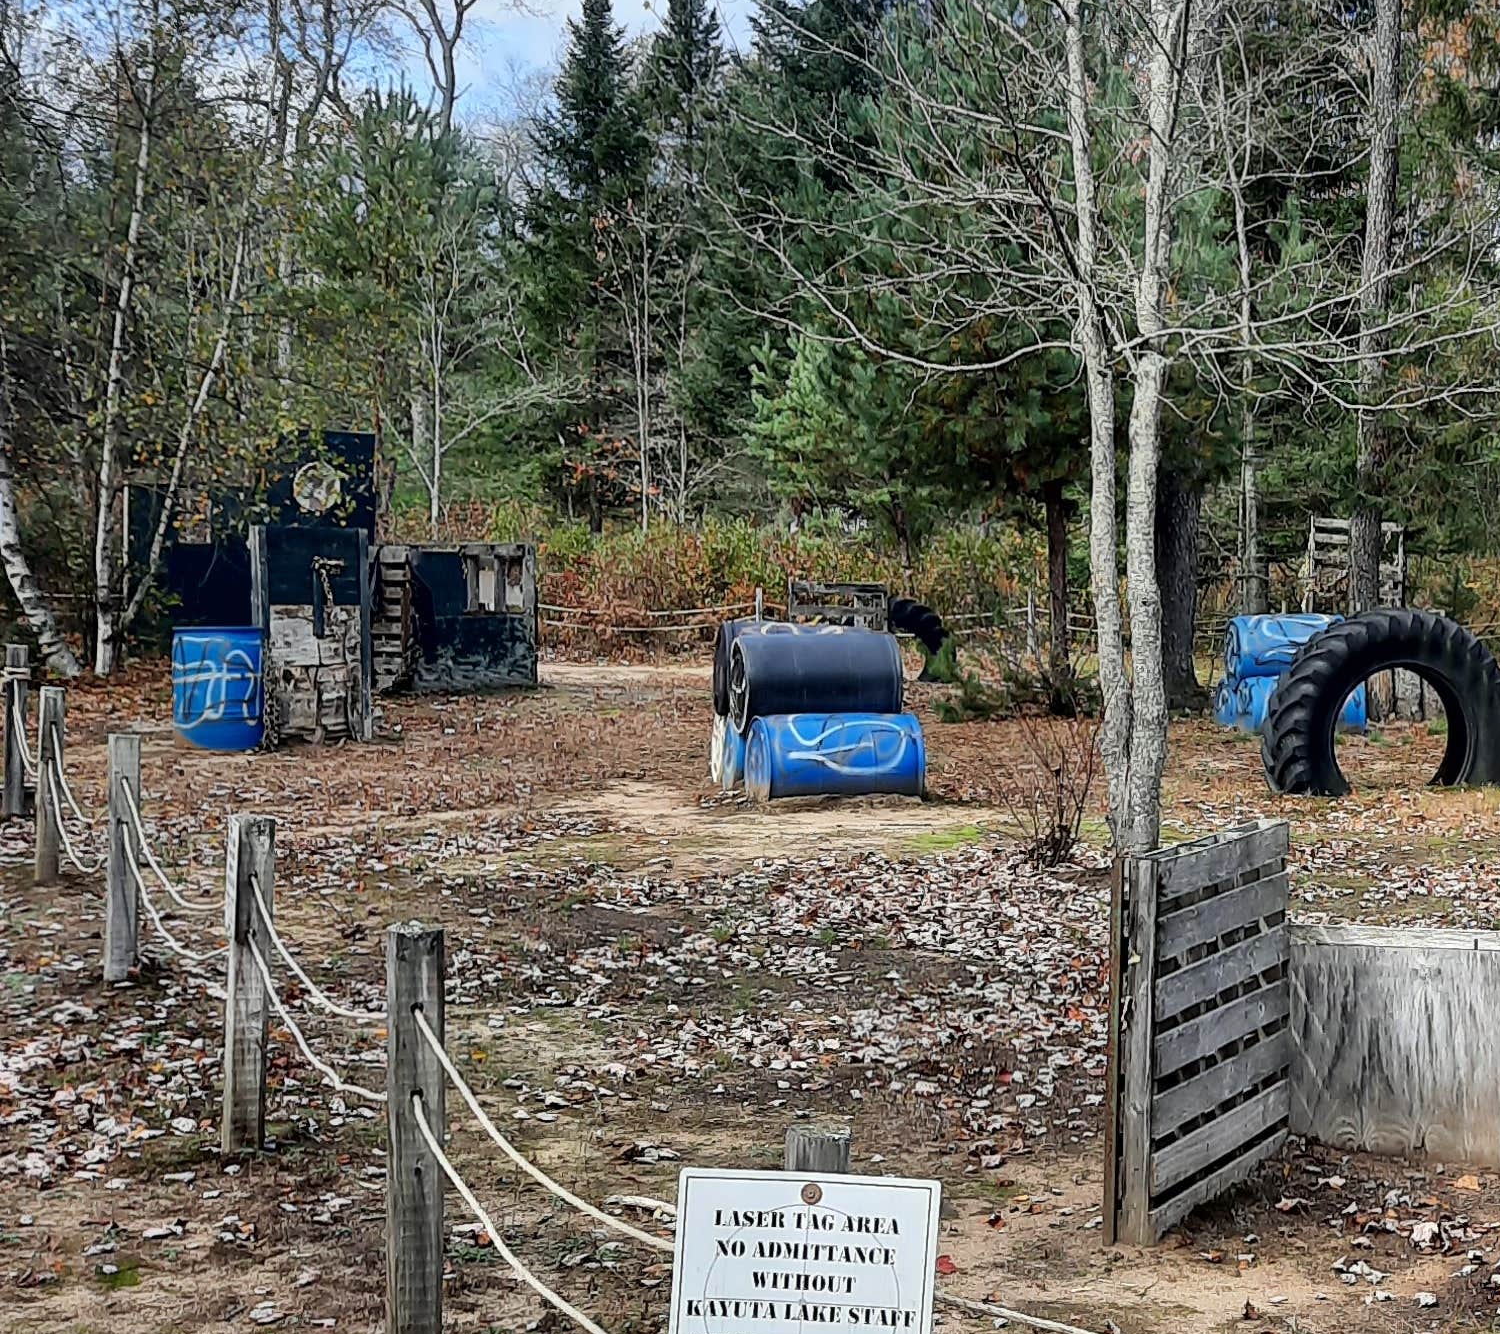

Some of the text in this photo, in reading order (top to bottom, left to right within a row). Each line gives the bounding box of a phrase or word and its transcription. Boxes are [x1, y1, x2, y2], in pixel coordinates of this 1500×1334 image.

[714, 1209, 900, 1235] LASER TAG AREA
[715, 1239, 897, 1266] NO ADMITTANCE
[752, 1271, 857, 1294] WITHOUT
[685, 1299, 917, 1328] KAYUTA LAKE STAFF
